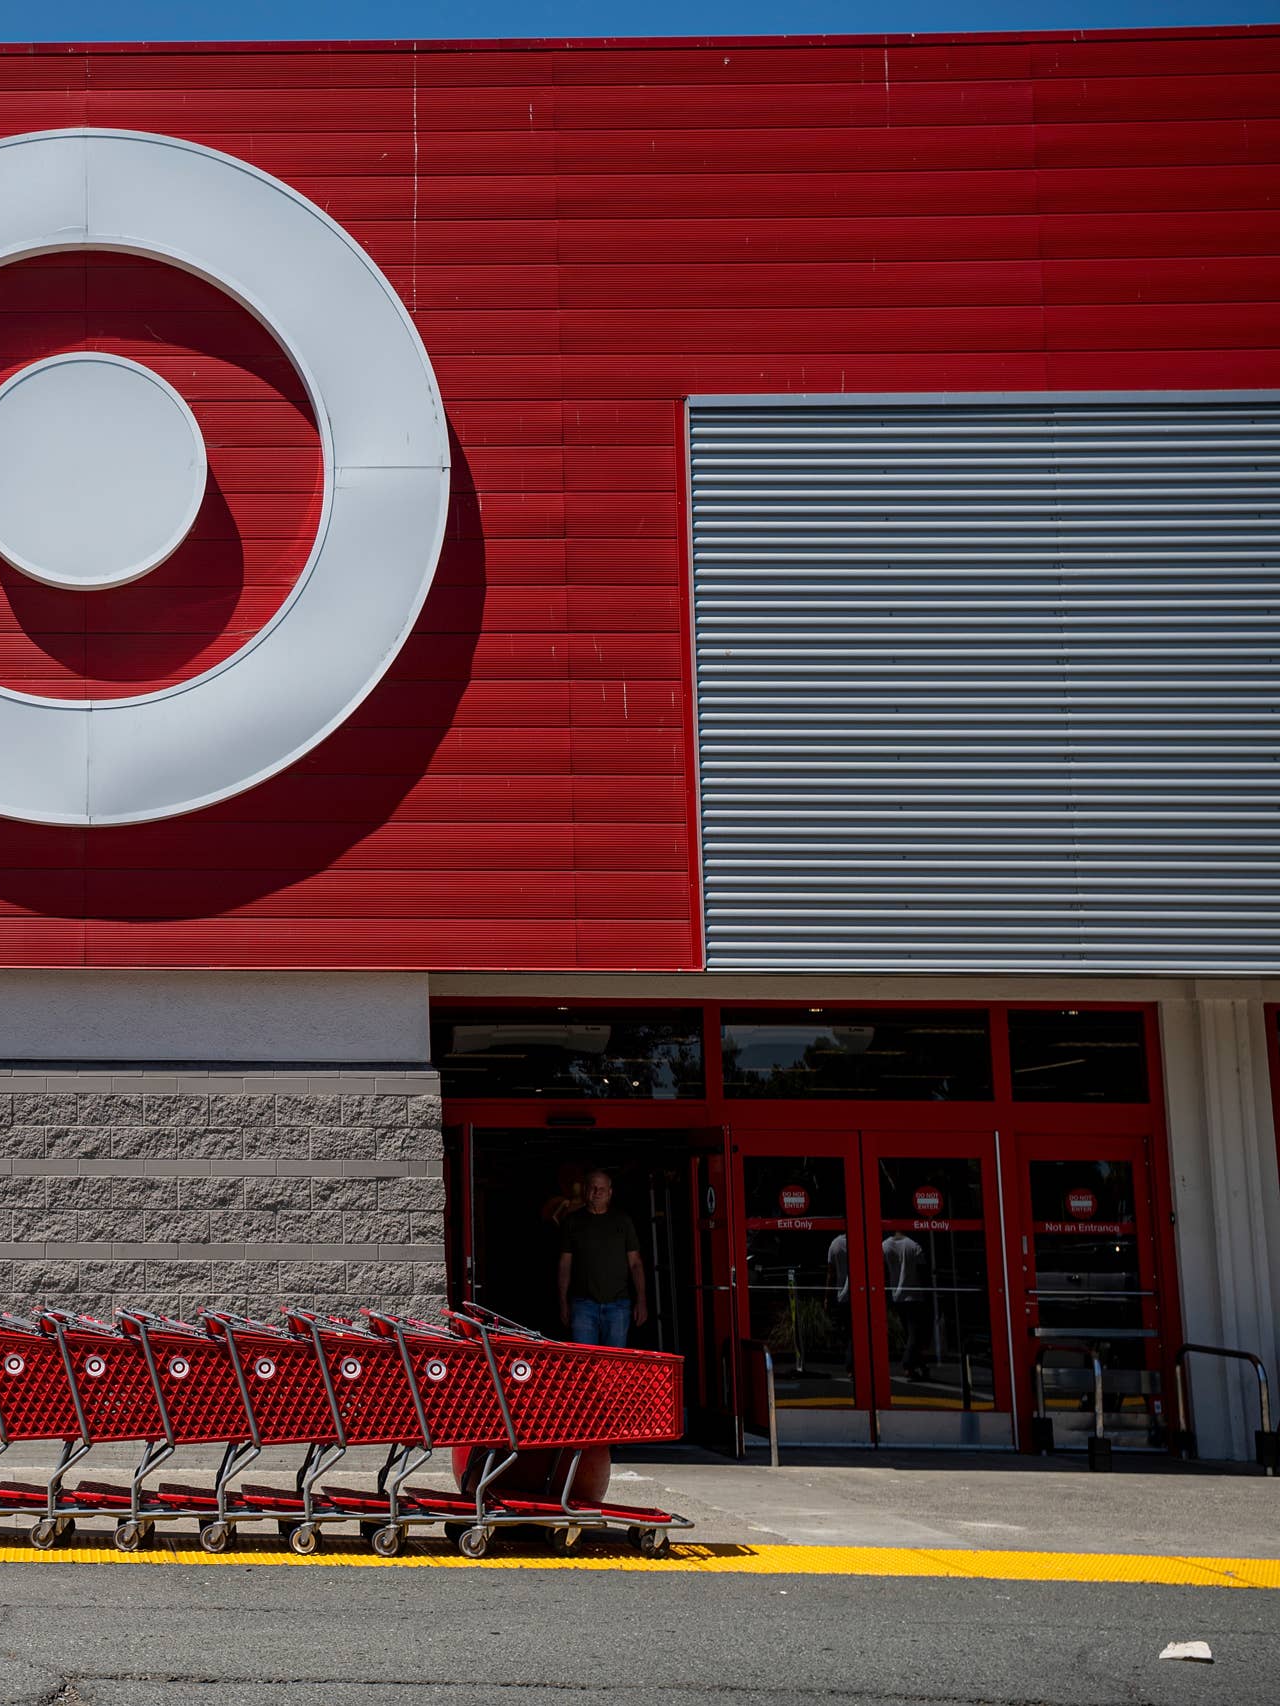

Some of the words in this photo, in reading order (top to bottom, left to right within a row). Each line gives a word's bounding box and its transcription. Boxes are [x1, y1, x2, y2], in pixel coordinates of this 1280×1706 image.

[778, 1220, 793, 1228] Exit
[794, 1220, 813, 1230] Only
[914, 1220, 929, 1229] Exit
[931, 1220, 949, 1230] Only
[1045, 1223, 1062, 1232] Not
[1078, 1223, 1120, 1232] Entrance
